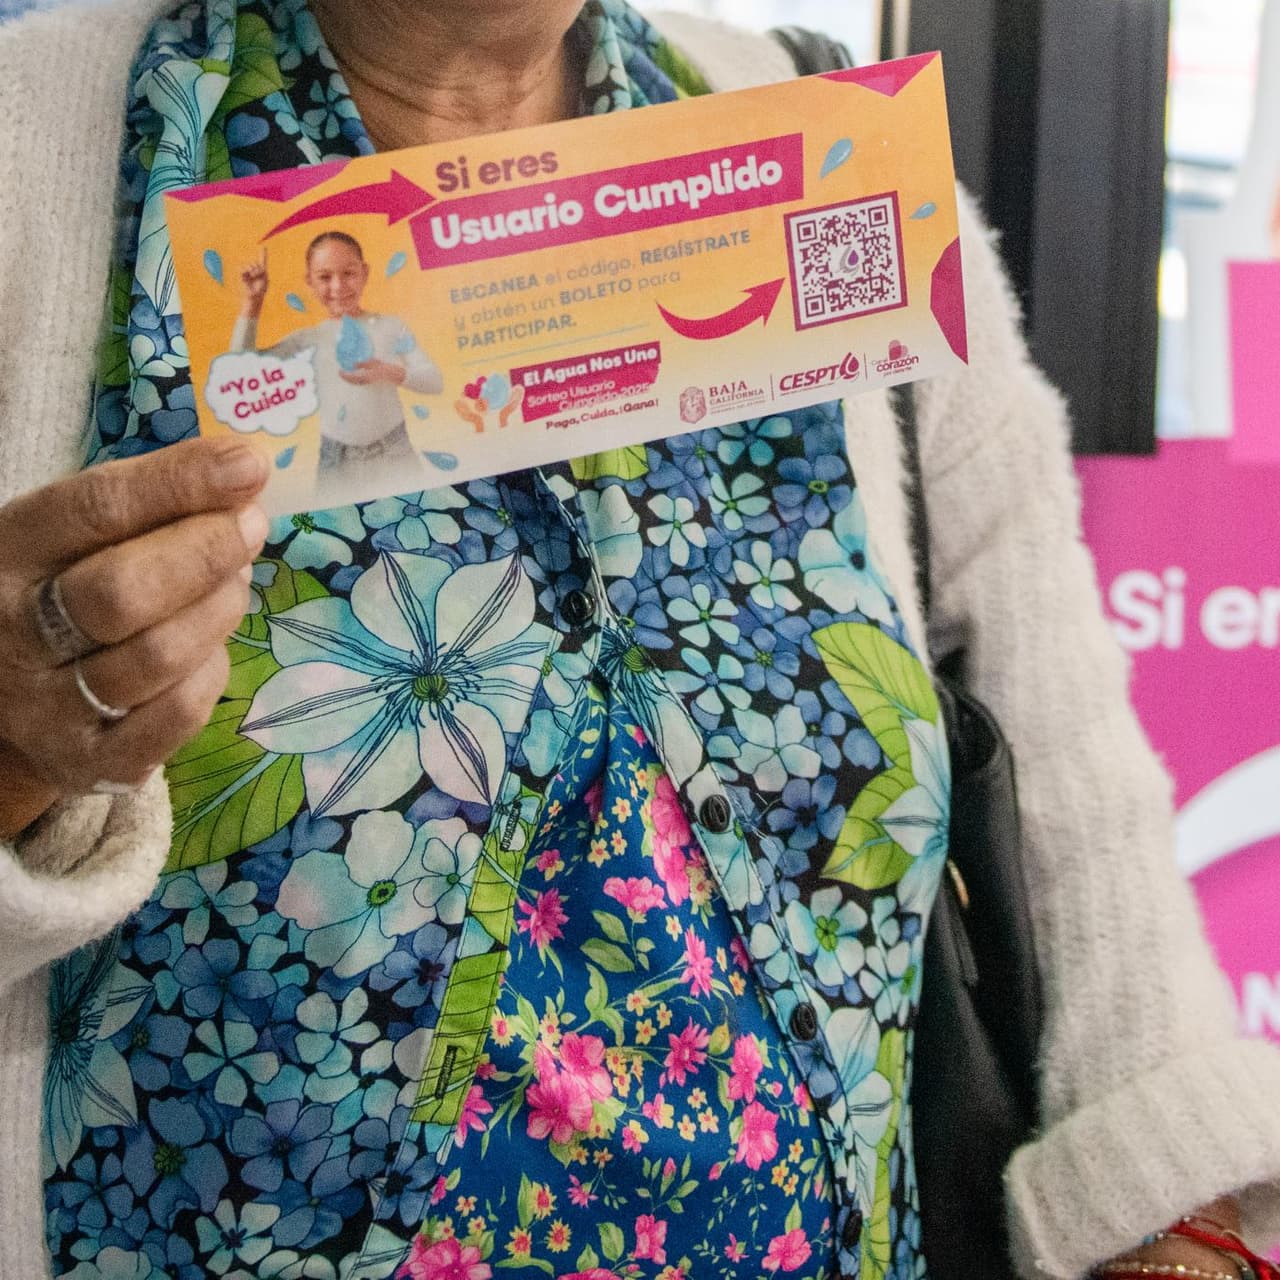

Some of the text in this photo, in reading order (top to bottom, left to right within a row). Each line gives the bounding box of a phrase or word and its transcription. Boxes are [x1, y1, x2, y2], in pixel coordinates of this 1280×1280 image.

[435, 150, 559, 193] Si eres
[430, 154, 783, 249] Usuario Cumplido
[450, 273, 538, 304] ESCANEA
[545, 267, 562, 284] el
[640, 229, 751, 266] REGÍSTRATE
[471, 302, 527, 324] obtén
[532, 297, 555, 312] un
[560, 277, 633, 305] BOLETO
[638, 270, 681, 292] para
[458, 314, 577, 350] PARTICIPAR.
[261, 368, 284, 384] la
[523, 347, 658, 387] El Agua Nos Une
[779, 363, 840, 392] CESPT
[876, 354, 919, 373] corazón
[526, 379, 616, 408] Sorteo Usuario
[709, 379, 749, 400] BAJA
[709, 387, 765, 406] CALIFORNIA
[1109, 566, 1186, 651] Si
